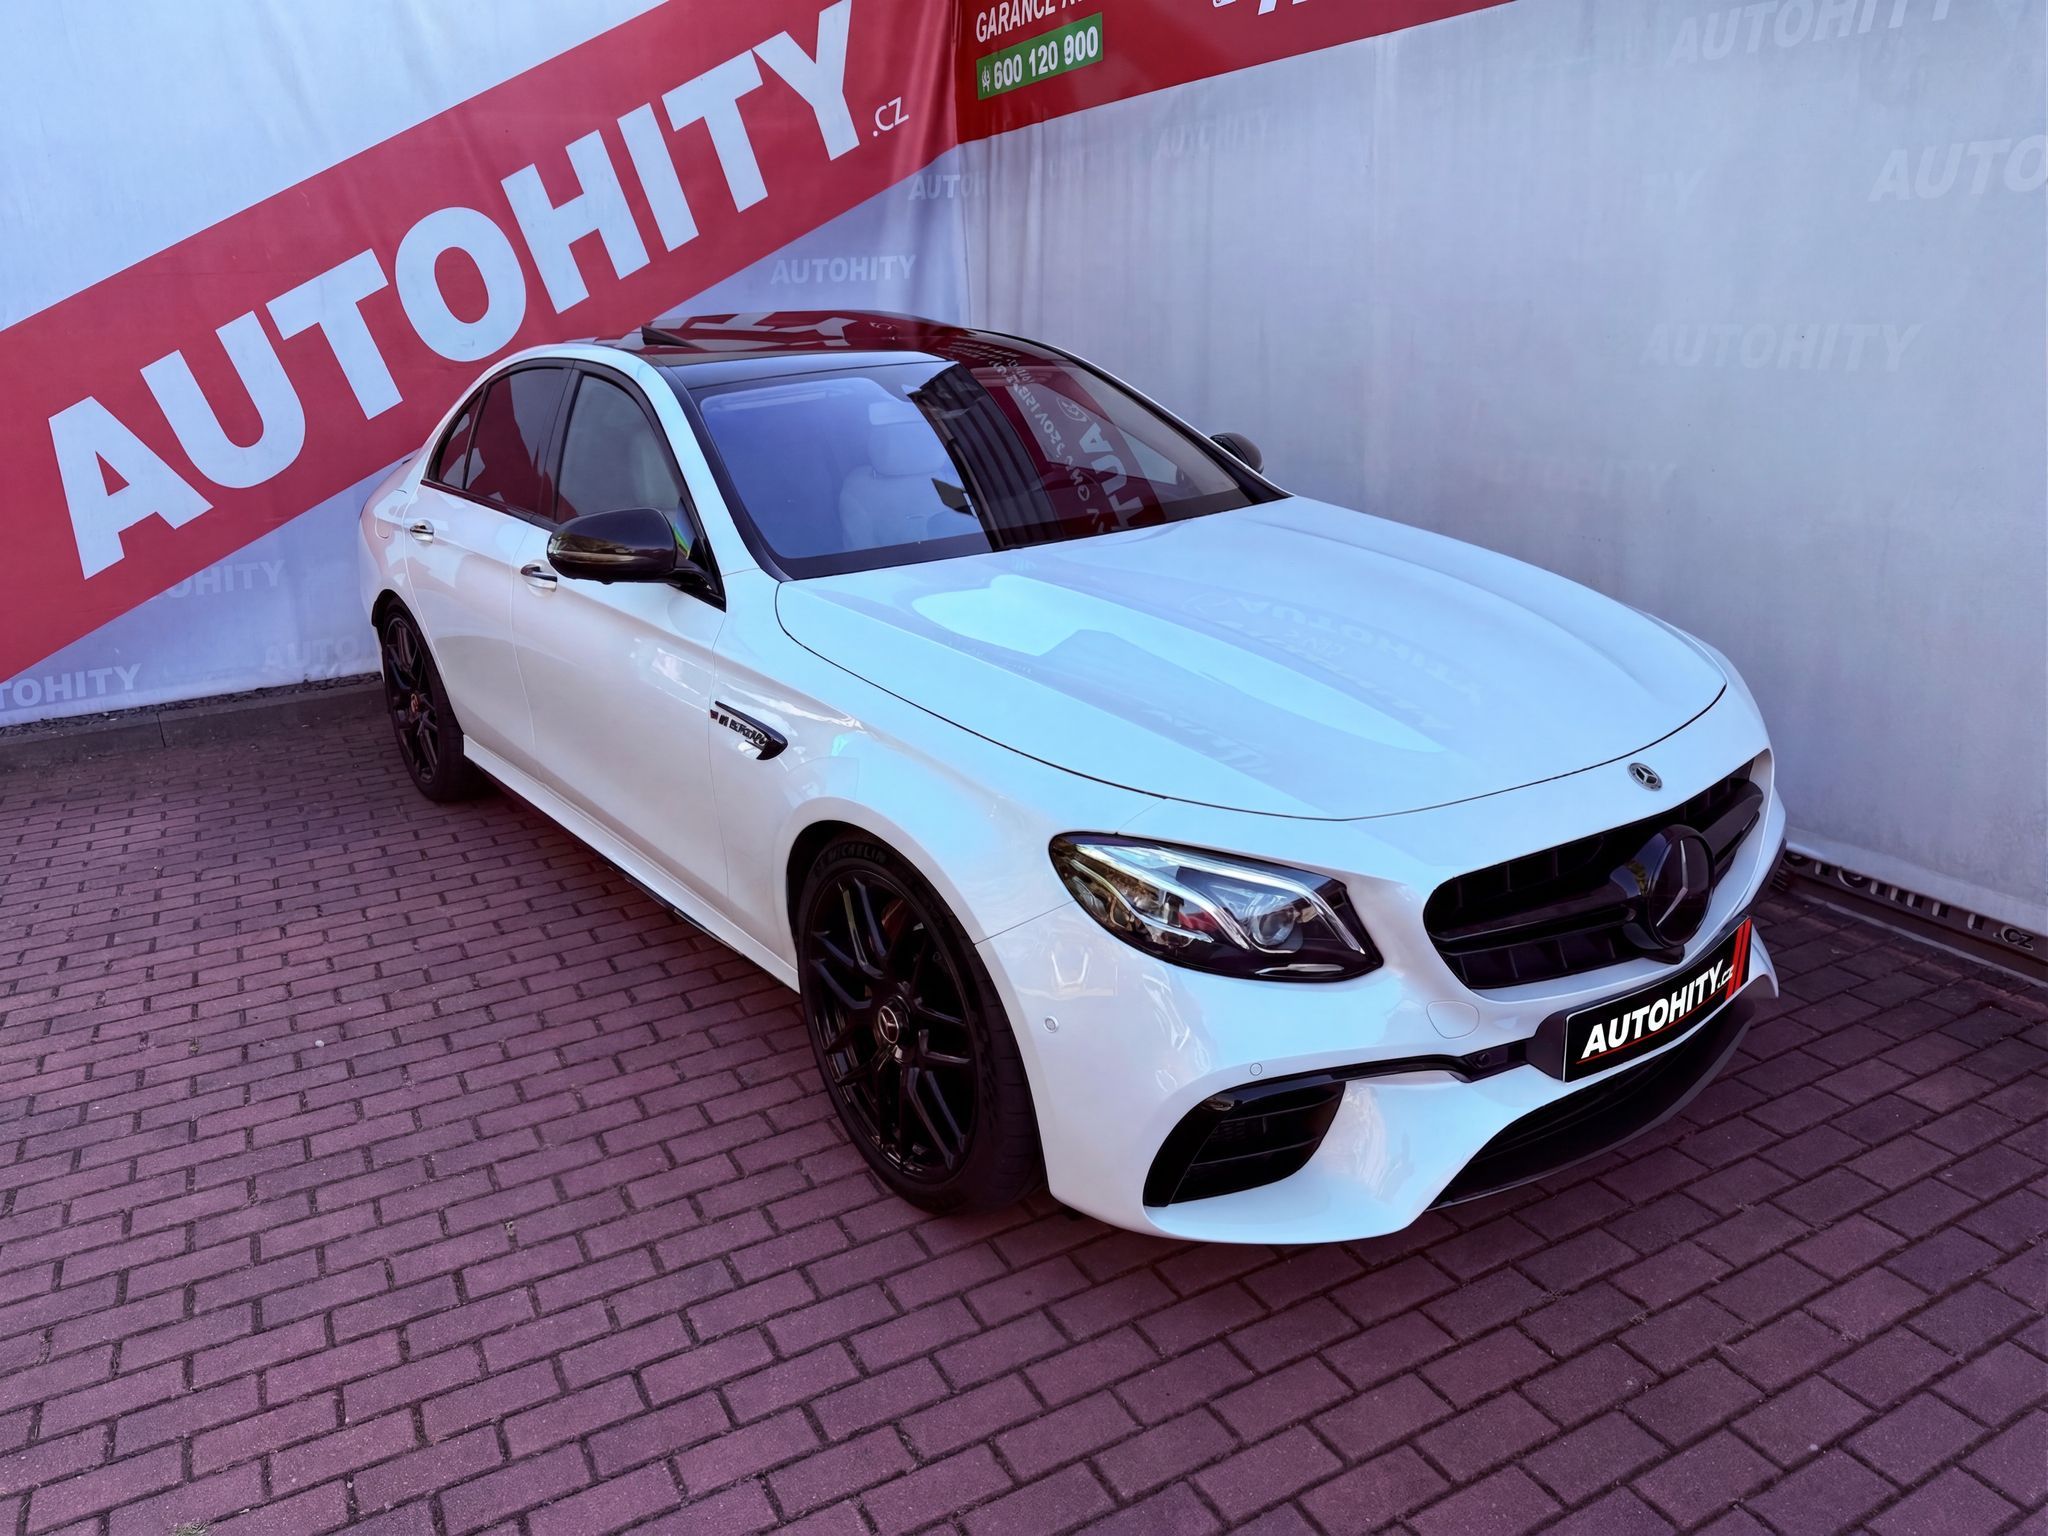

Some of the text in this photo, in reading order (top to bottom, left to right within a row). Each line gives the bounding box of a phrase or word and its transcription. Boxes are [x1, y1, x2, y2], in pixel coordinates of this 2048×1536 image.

[993, 26, 1099, 91] 600 120 900
[769, 254, 917, 285] AUTOHITY
[1639, 322, 1922, 373] AUTOHITY
